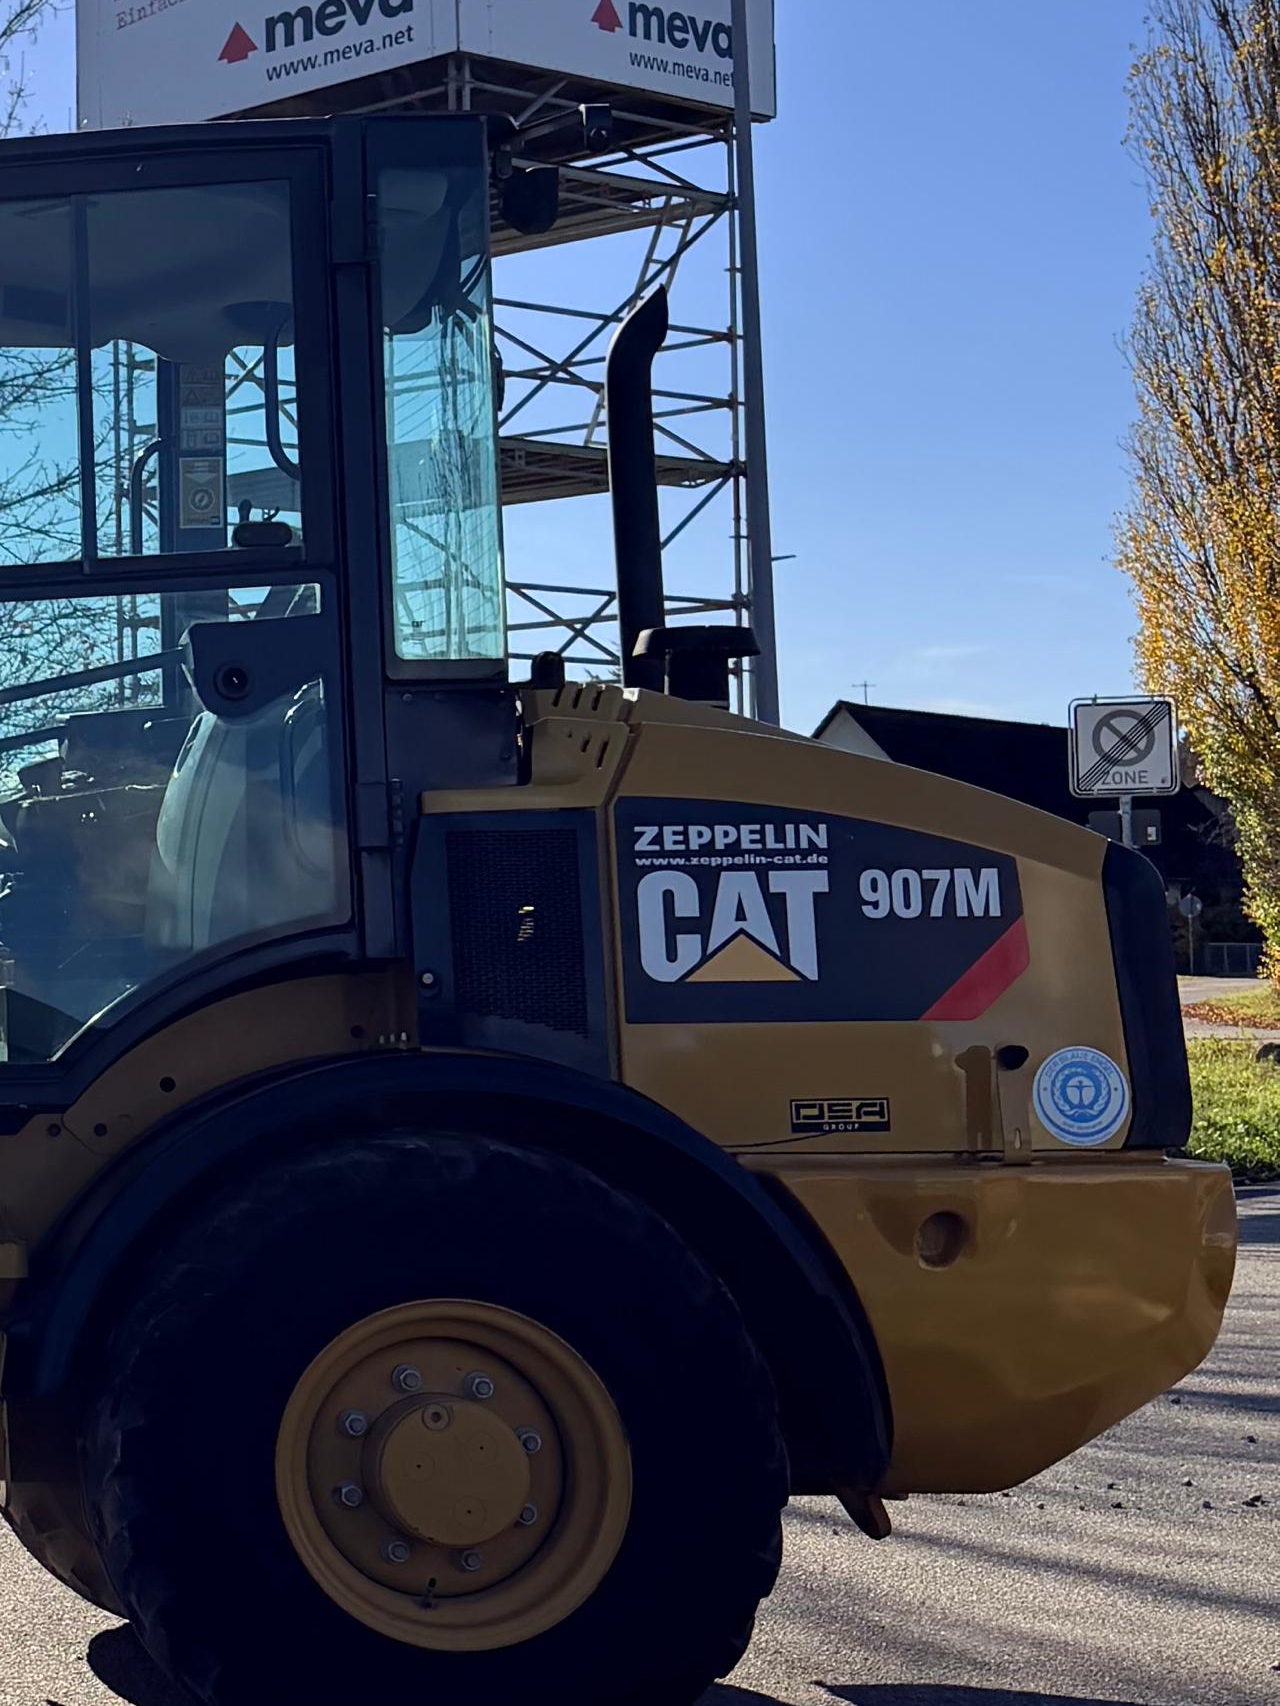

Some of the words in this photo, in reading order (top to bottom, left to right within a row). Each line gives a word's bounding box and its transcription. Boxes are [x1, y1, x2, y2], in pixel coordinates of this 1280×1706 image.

[628, 1, 734, 59] meva
[265, 24, 415, 82] www.meva.net
[1101, 769, 1149, 786] ZONE
[633, 823, 829, 851] ZEPPELIN
[634, 853, 829, 866] www.zeppelin-cat.de
[859, 867, 1002, 918] 907M
[637, 869, 829, 983] CAT
[822, 1123, 861, 1131] GROUP
